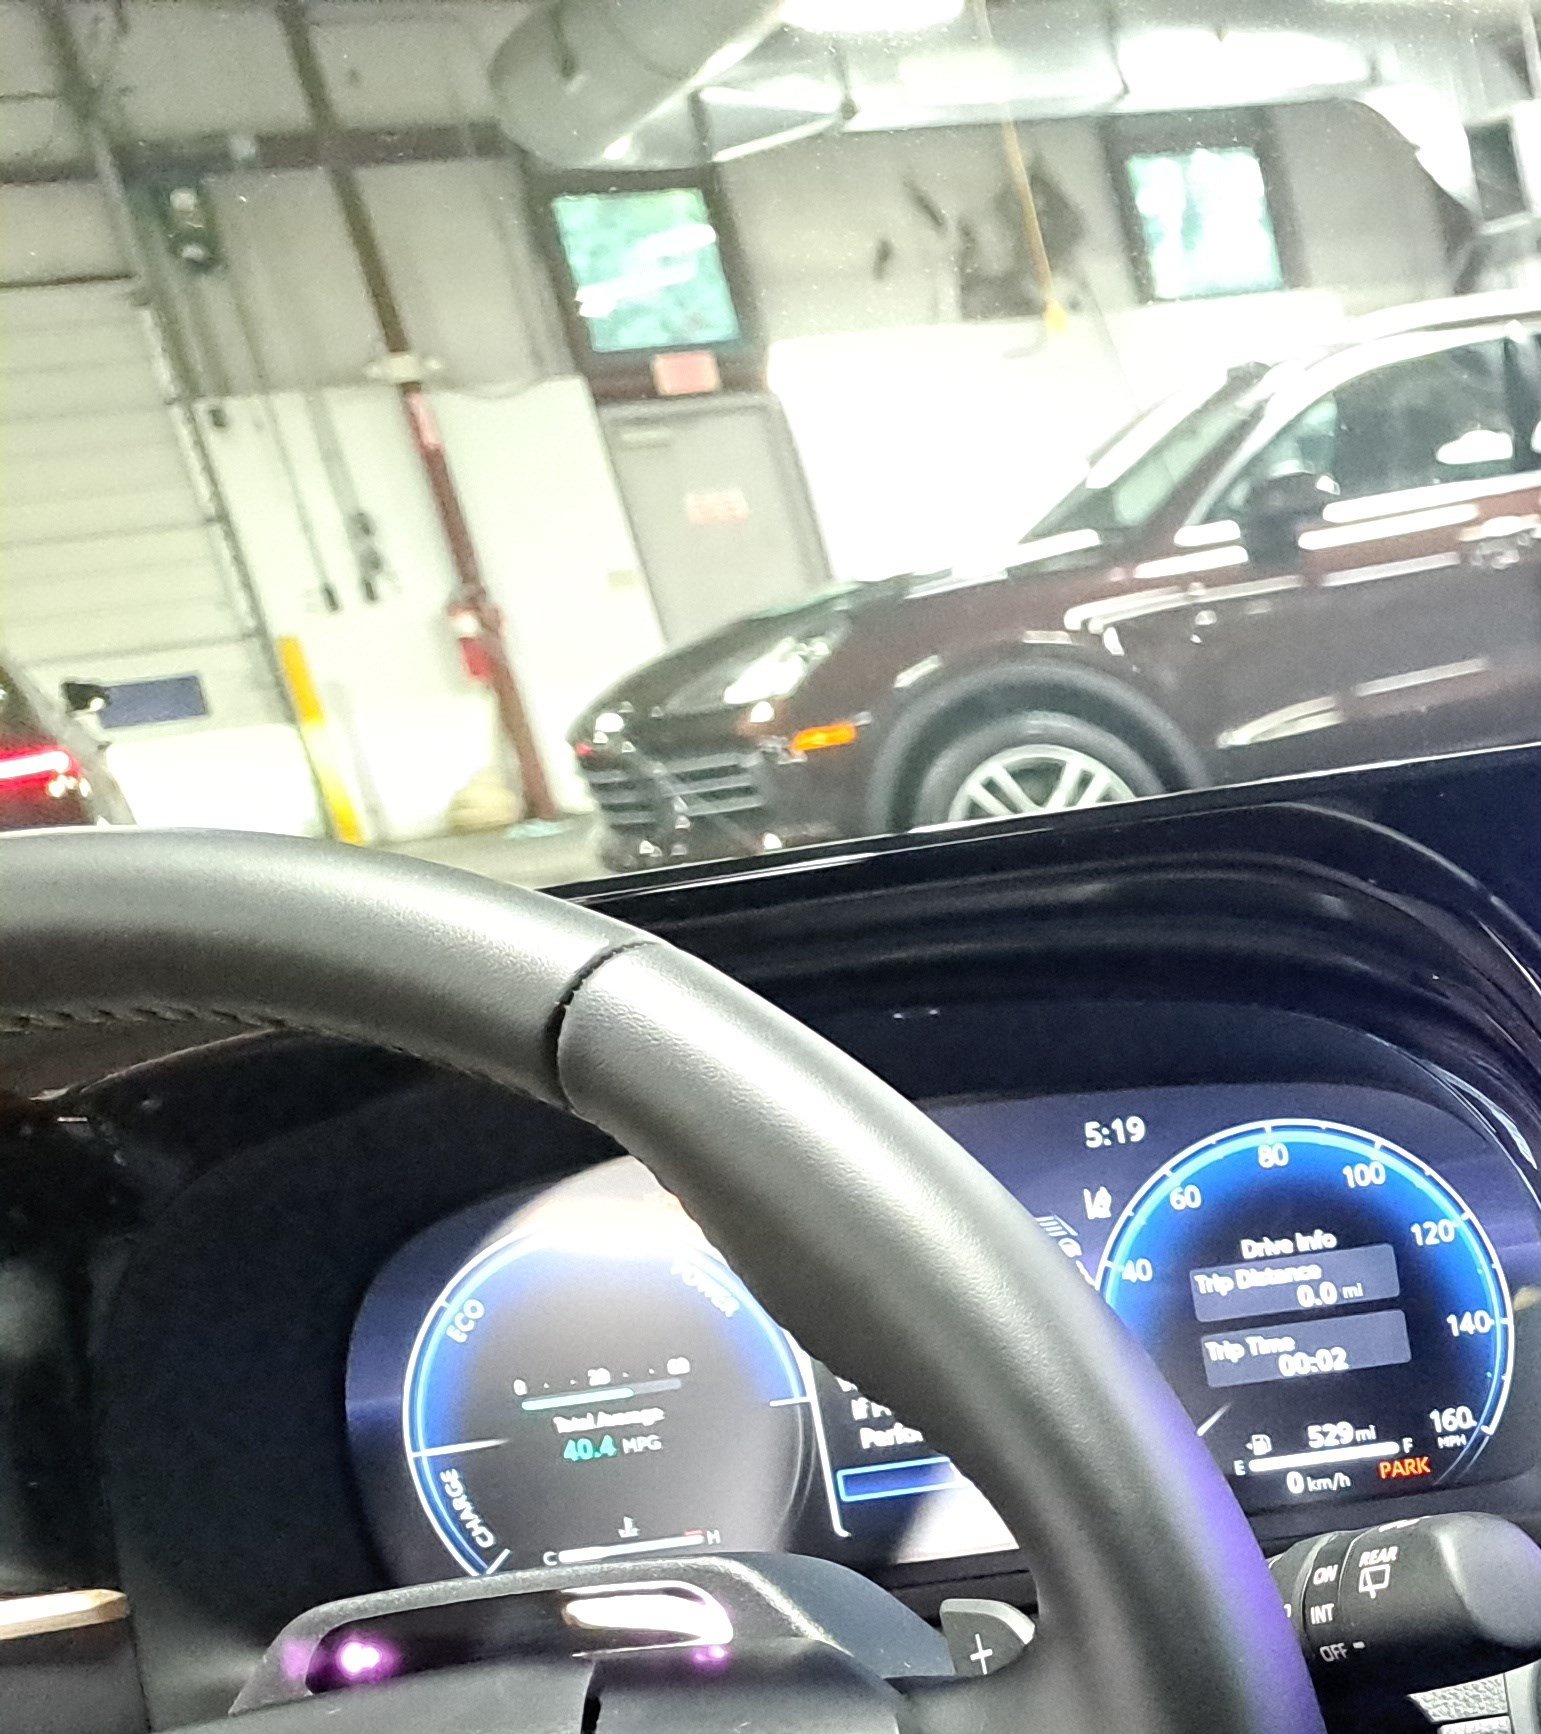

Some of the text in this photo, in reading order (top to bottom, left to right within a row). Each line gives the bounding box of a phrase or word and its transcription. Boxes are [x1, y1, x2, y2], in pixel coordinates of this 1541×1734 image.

[1084, 1117, 1146, 1148] 5:19
[1257, 1143, 1289, 1169] 80
[1342, 1161, 1386, 1188] 100
[1169, 1185, 1202, 1210] 60
[1241, 1229, 1338, 1260] Drive Info
[1410, 1218, 1455, 1247] 120
[1122, 1259, 1153, 1283] 40
[1194, 1264, 1323, 1297] Trip Distance
[1296, 1281, 1364, 1308] 0.0 mi
[446, 1298, 486, 1343] ECO
[1446, 1310, 1491, 1337] 140
[1204, 1336, 1296, 1364] Trip Time
[1278, 1346, 1350, 1377] 00:02
[1429, 1405, 1474, 1434] 160
[563, 1434, 662, 1461] 40.4 MPG
[1306, 1421, 1377, 1450] 529 mi
[1402, 1437, 1414, 1454] F
[1437, 1434, 1467, 1450] MPH
[1233, 1460, 1246, 1476] E
[1378, 1456, 1431, 1479] PARK
[1286, 1471, 1352, 1494] 0 km/h
[440, 1468, 495, 1548] CHARGE
[706, 1529, 721, 1544] H
[543, 1551, 558, 1567] C
[1358, 1546, 1399, 1568] REAR
[1312, 1564, 1339, 1586] ON
[1310, 1602, 1335, 1625] INT
[1318, 1642, 1349, 1663] OFF
